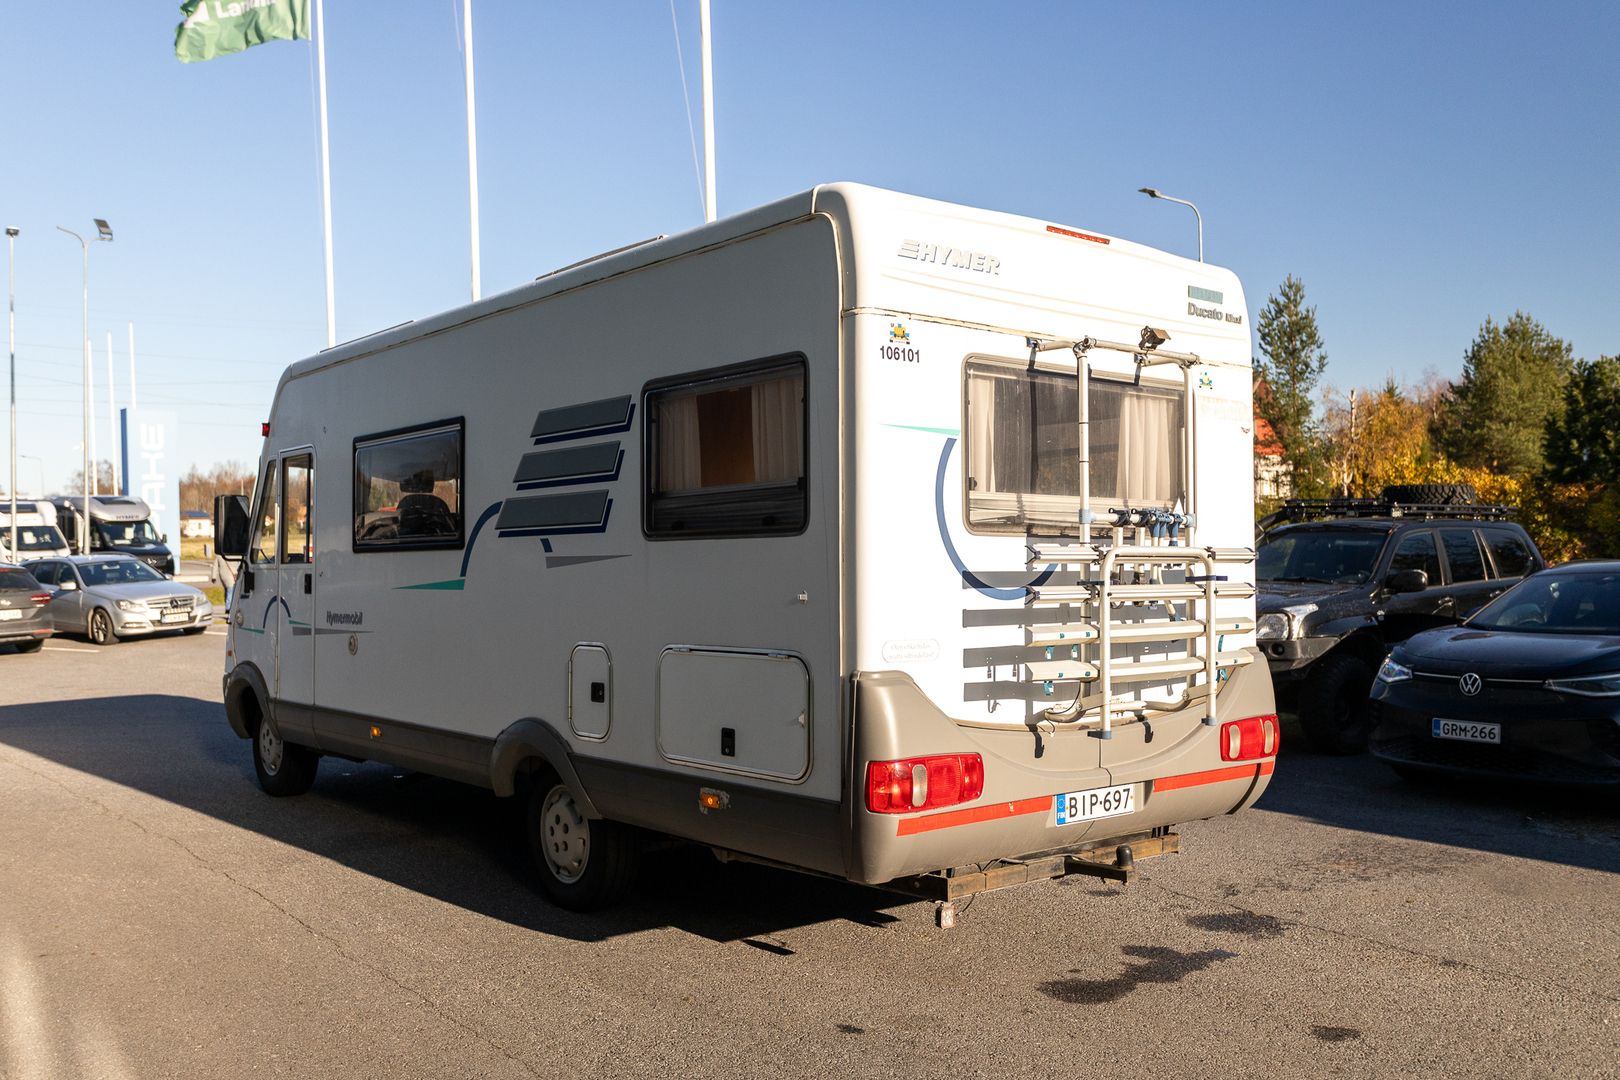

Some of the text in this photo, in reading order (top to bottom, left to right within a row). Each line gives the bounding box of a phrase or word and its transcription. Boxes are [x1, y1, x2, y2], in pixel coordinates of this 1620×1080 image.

[918, 241, 1000, 276] HYMER
[1187, 302, 1223, 321] Ducato
[880, 345, 920, 363] 106101
[1442, 722, 1497, 740] GRM-266
[1069, 788, 1131, 818] BIP-697
